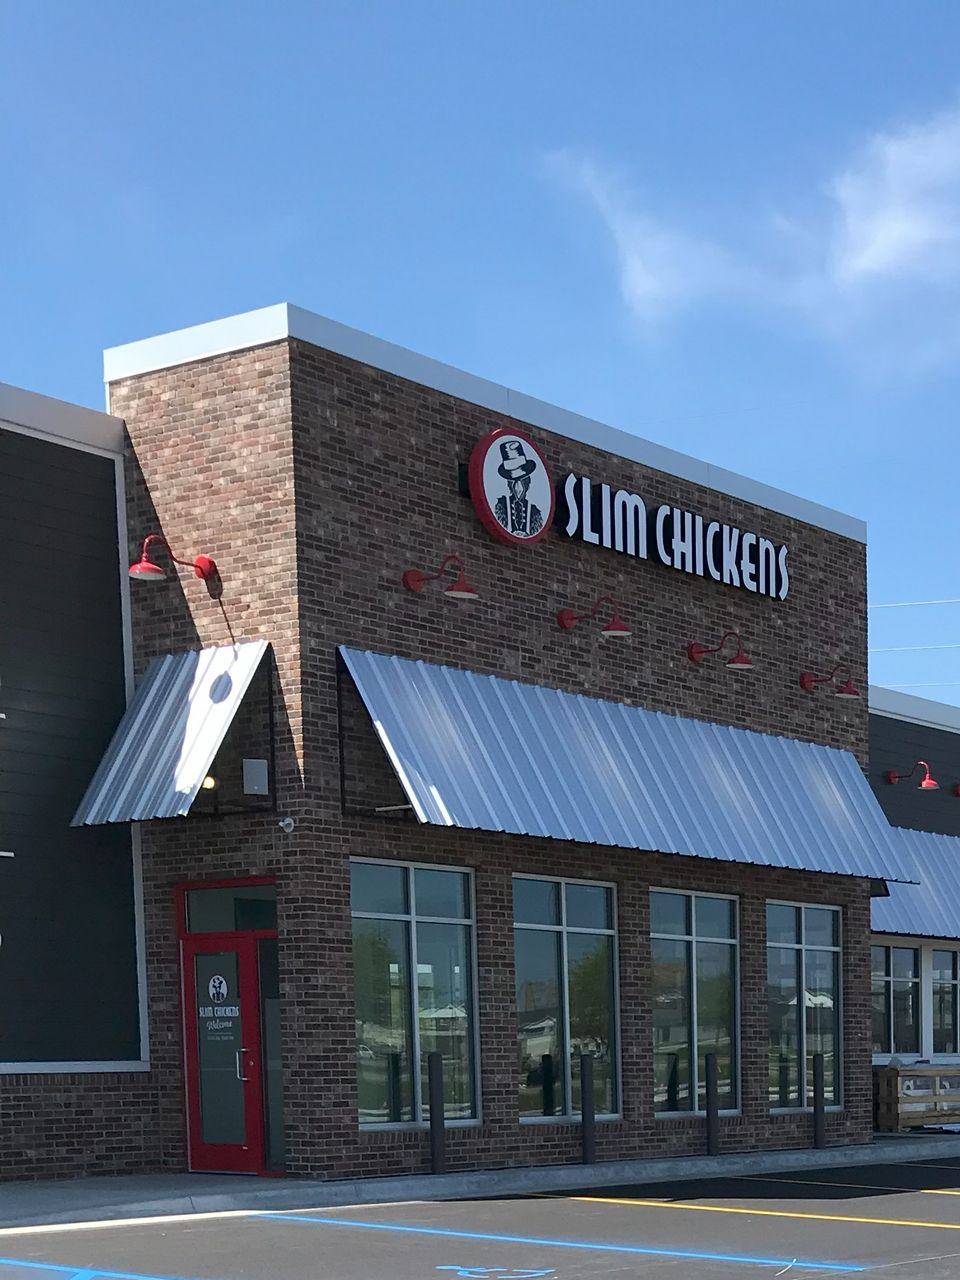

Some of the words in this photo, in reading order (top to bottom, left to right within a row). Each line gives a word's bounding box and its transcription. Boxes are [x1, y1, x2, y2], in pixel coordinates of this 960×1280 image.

[564, 473, 647, 560] SLIM
[655, 504, 789, 601] CHICKENS
[199, 1007, 213, 1017] SLIM
[214, 1006, 239, 1017] CHICKENS
